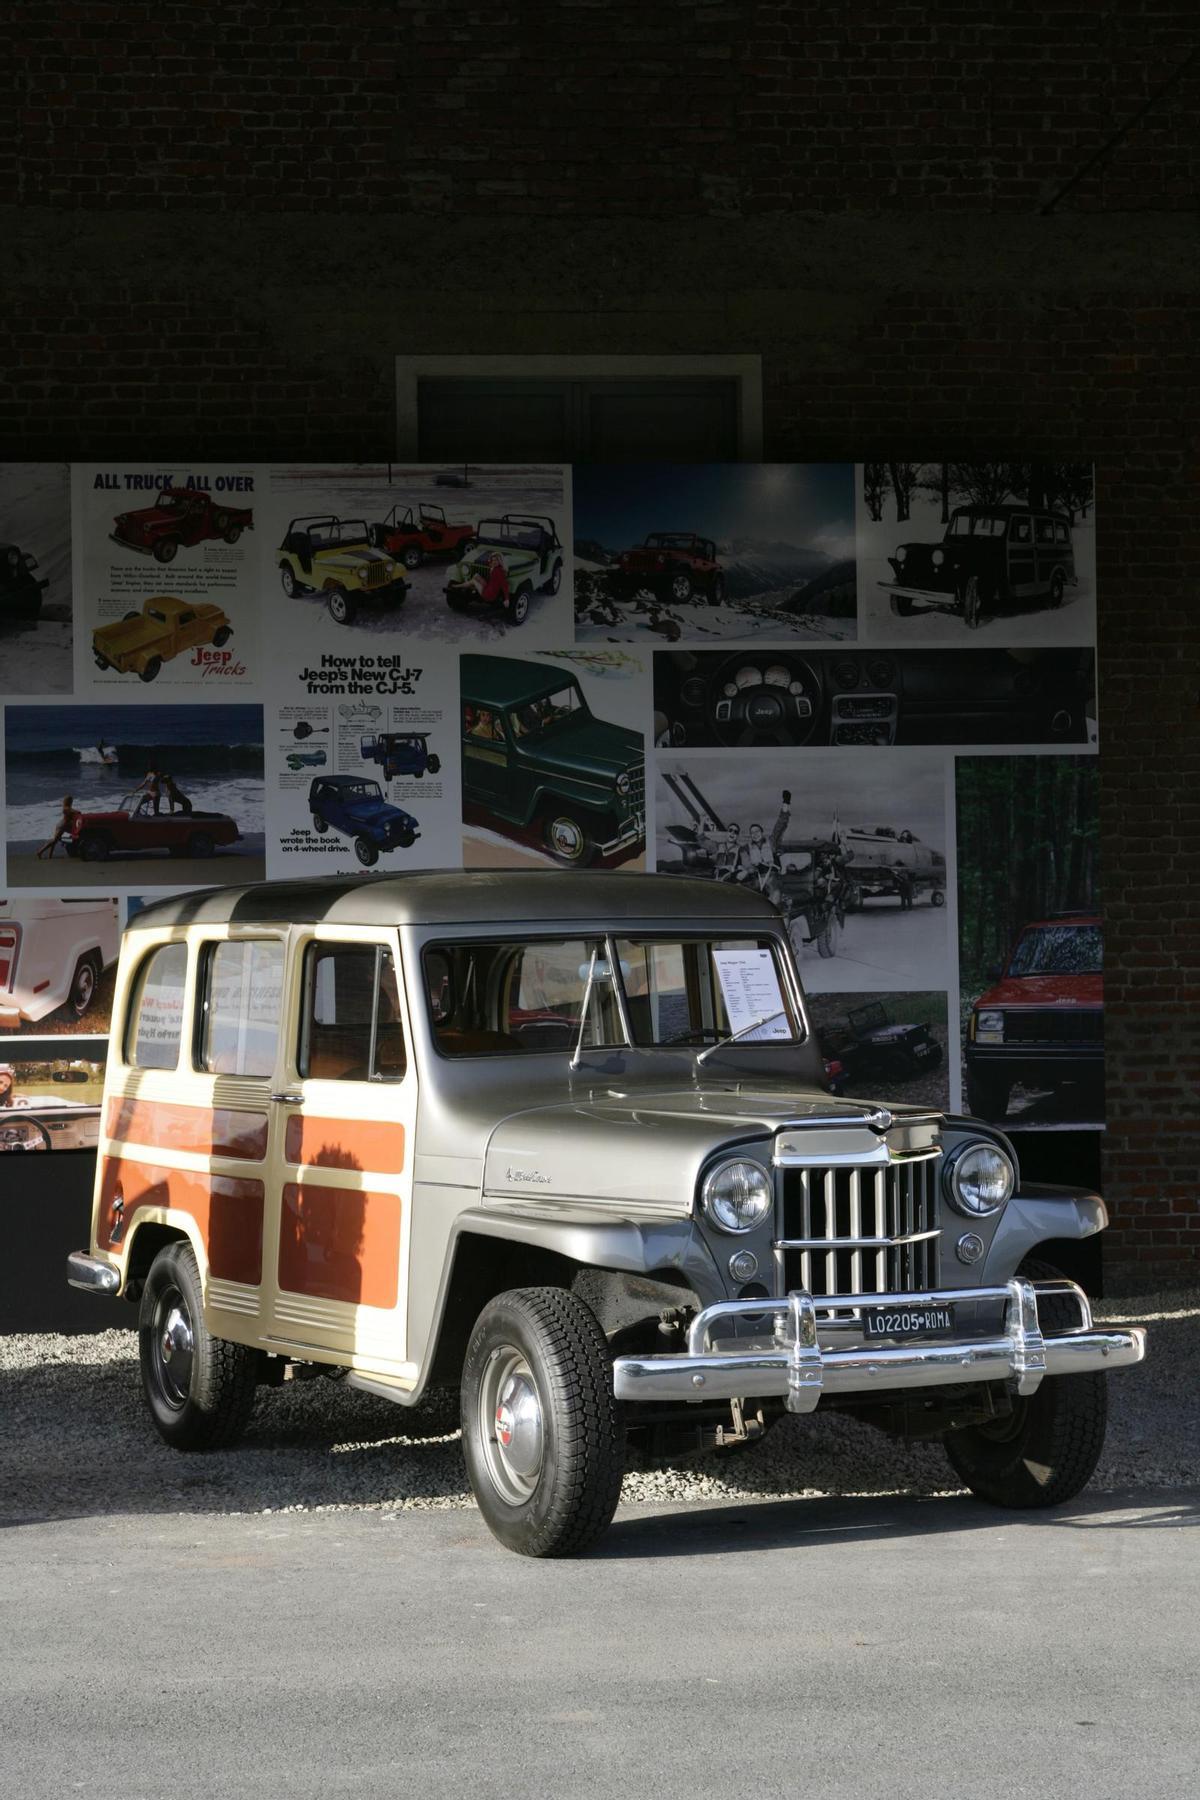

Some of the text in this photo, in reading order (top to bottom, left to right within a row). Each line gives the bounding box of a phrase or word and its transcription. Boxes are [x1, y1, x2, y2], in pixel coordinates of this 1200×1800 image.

[94, 474, 254, 491] ALL TRUCK ALL OVER
[321, 655, 401, 667] How to tell
[202, 661, 246, 678] Trucks
[299, 668, 423, 683] Jeep's New CJ-7
[307, 682, 416, 694] from the CJ-5.
[290, 829, 311, 838] Jeep
[924, 1311, 951, 1329] ROMA
